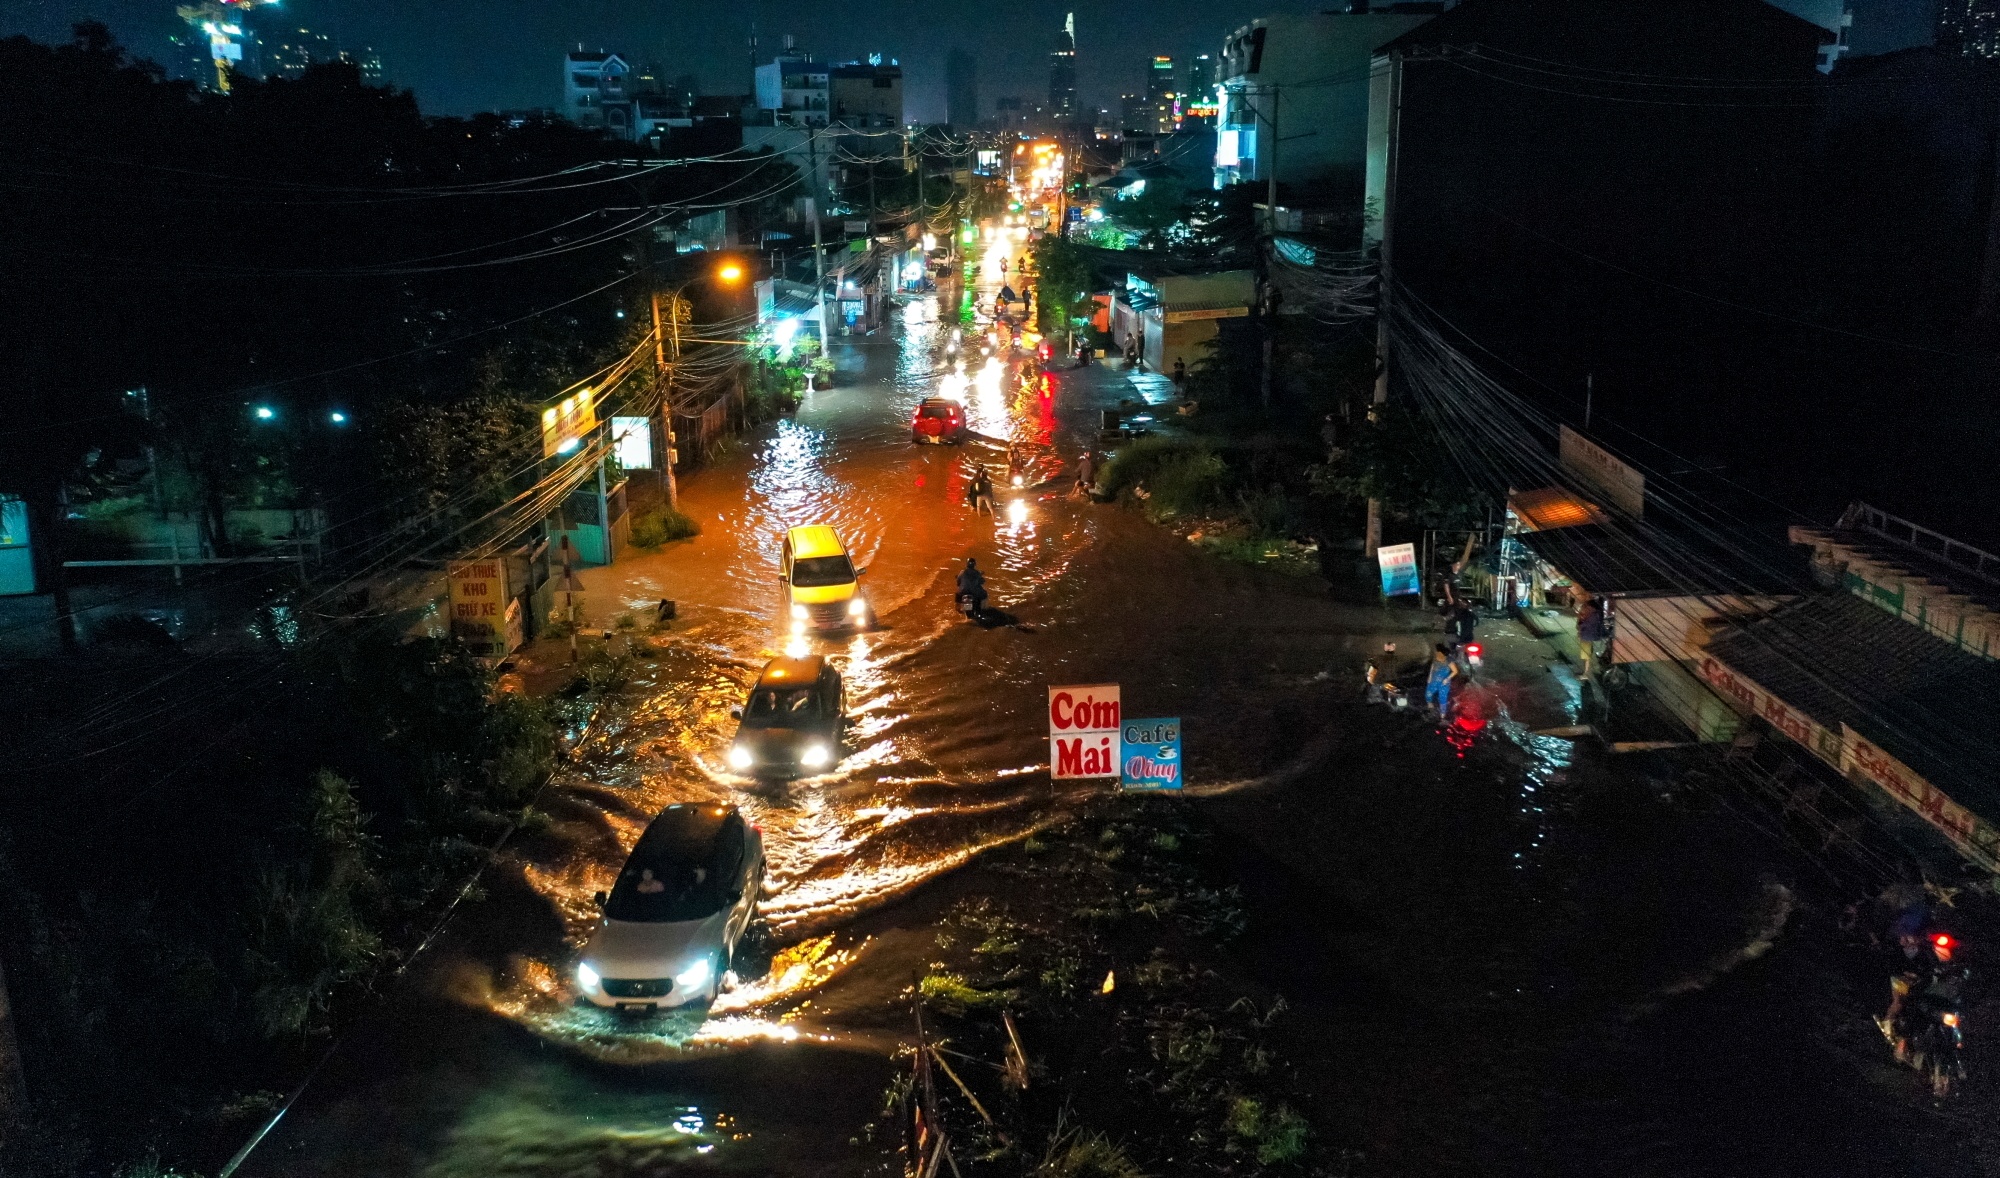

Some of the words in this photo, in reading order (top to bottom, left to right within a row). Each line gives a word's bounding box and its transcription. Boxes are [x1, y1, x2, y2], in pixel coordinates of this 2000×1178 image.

[463, 582, 487, 596] KHO
[457, 600, 479, 616] GIỮ
[481, 602, 497, 616] XE
[1051, 692, 1119, 729] Cơm
[1765, 696, 1810, 746] Mai
[1056, 737, 1112, 775] Mai
